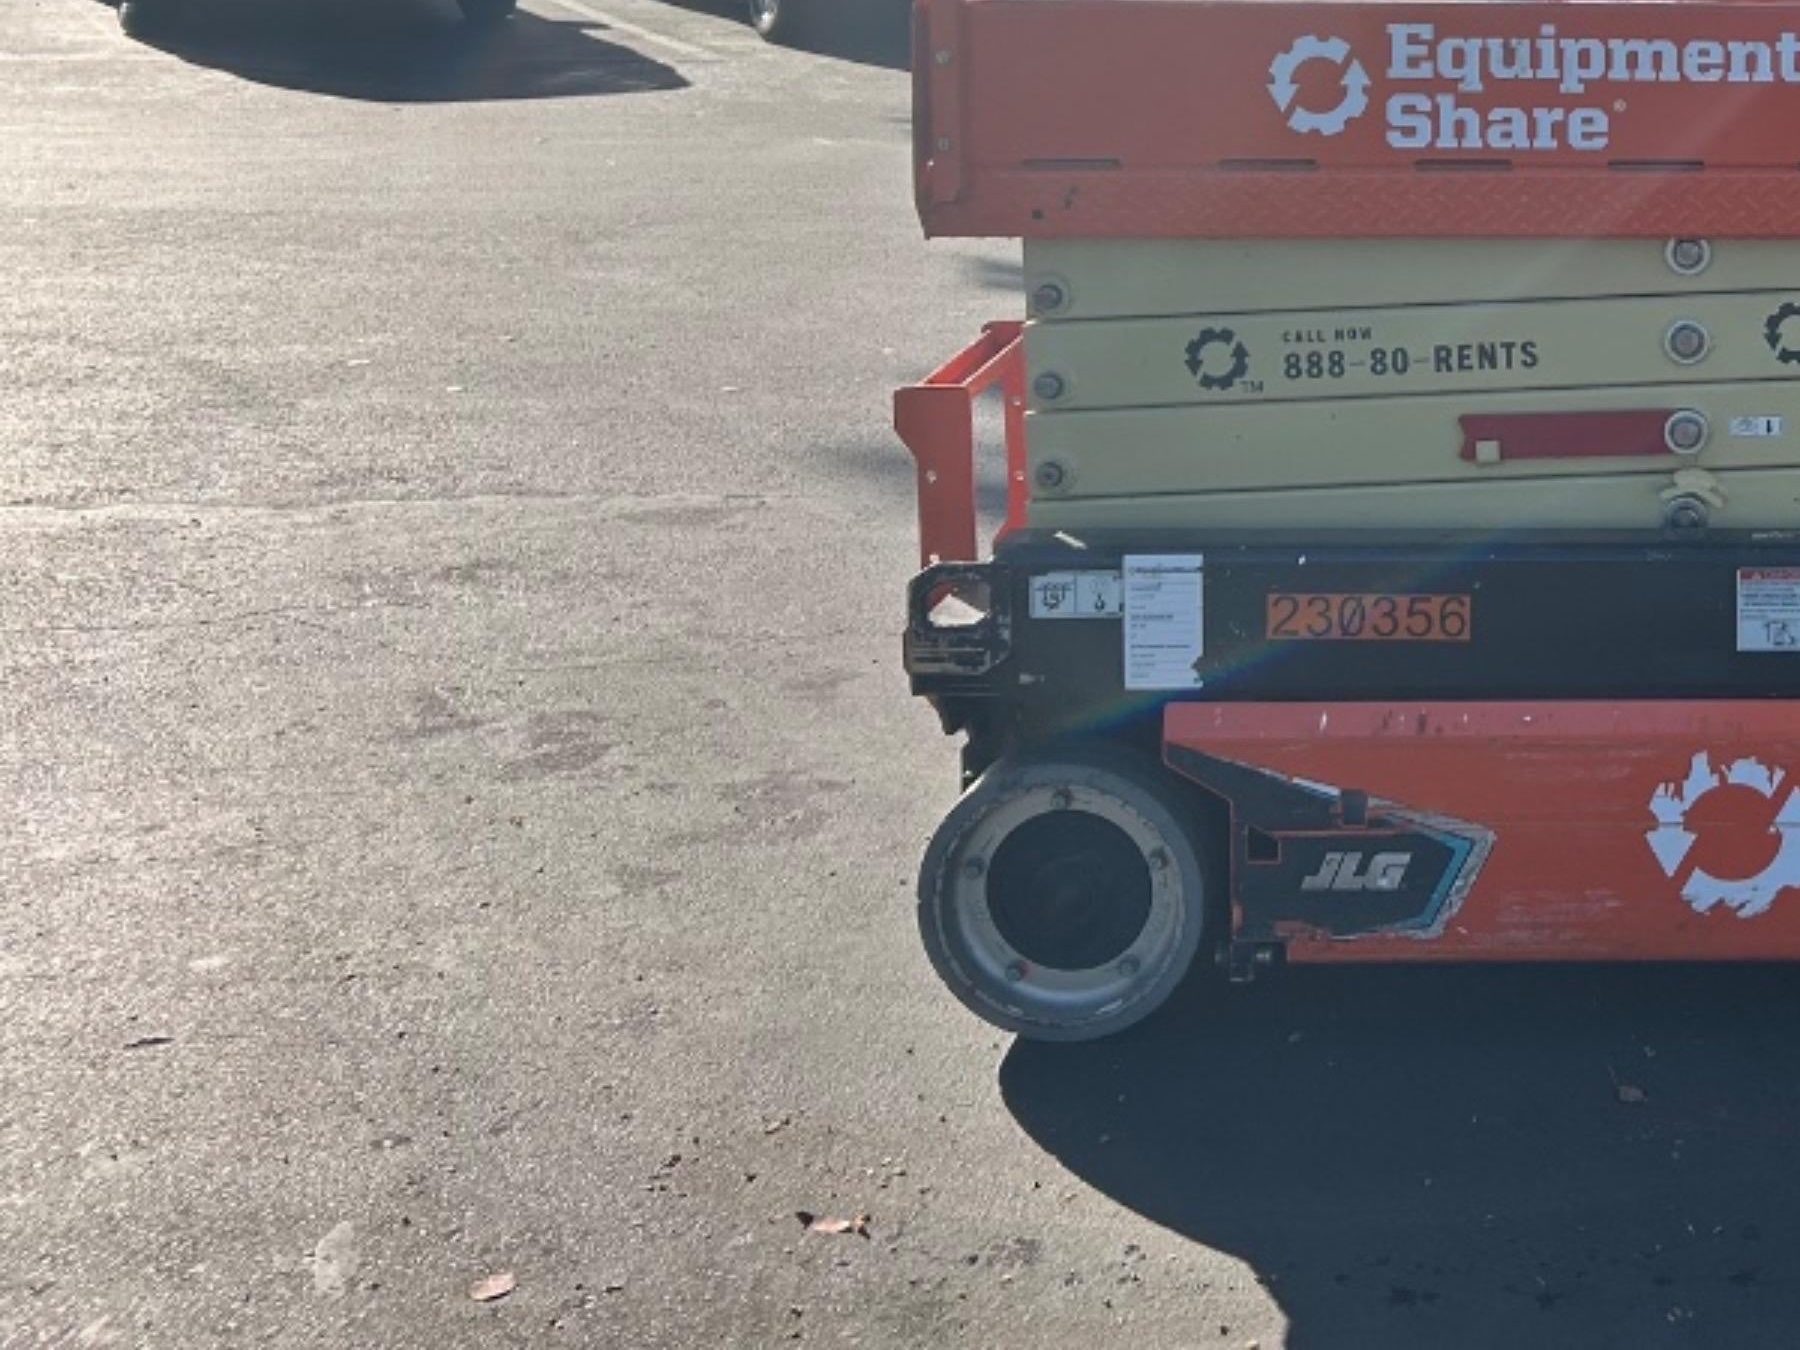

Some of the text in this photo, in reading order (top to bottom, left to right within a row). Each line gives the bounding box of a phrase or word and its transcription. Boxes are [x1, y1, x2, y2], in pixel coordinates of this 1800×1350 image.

[1384, 92, 1609, 149] Share
[1282, 326, 1373, 344] CALL NOW
[1283, 340, 1540, 381] 888-80-RENTS
[1270, 595, 1468, 638] 230356
[1300, 851, 1412, 890] JLG
